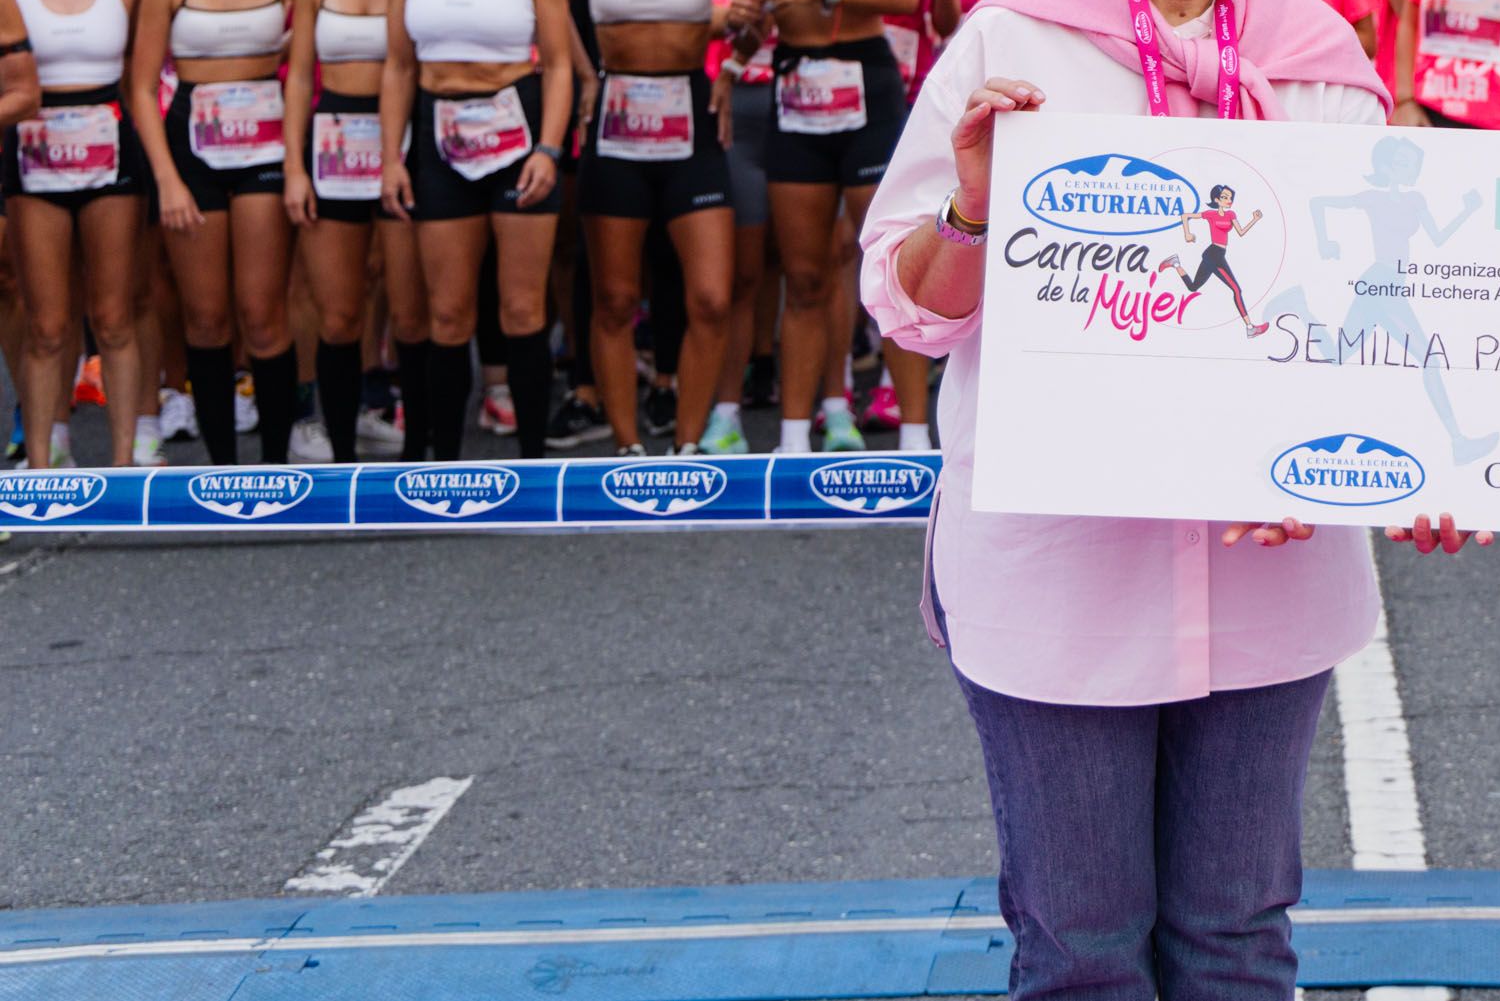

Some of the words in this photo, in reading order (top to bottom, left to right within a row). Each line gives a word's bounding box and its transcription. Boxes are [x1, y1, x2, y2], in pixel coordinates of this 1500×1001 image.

[1064, 180, 1120, 190] CENTRAL
[1126, 183, 1182, 193] LECHERA
[1036, 181, 1185, 217] ASTURIANA
[1004, 227, 1150, 273] Carrera
[1397, 259, 1418, 275] La
[1348, 280, 1416, 298] “Central
[1422, 283, 1490, 301] Lechera
[1037, 273, 1064, 302] de
[1070, 274, 1090, 303] la
[1084, 271, 1202, 341] Mujer
[1282, 458, 1413, 489] ASTURIANA
[1306, 457, 1356, 466] CENTRAL
[1360, 459, 1409, 468] LECHERA
[0, 477, 98, 499] ASTURIAN
[199, 475, 304, 498] ASTURIANA
[405, 472, 511, 495] ASTURIANA
[612, 470, 719, 494] ASTURIANA
[820, 469, 926, 492] ASTURIANA
